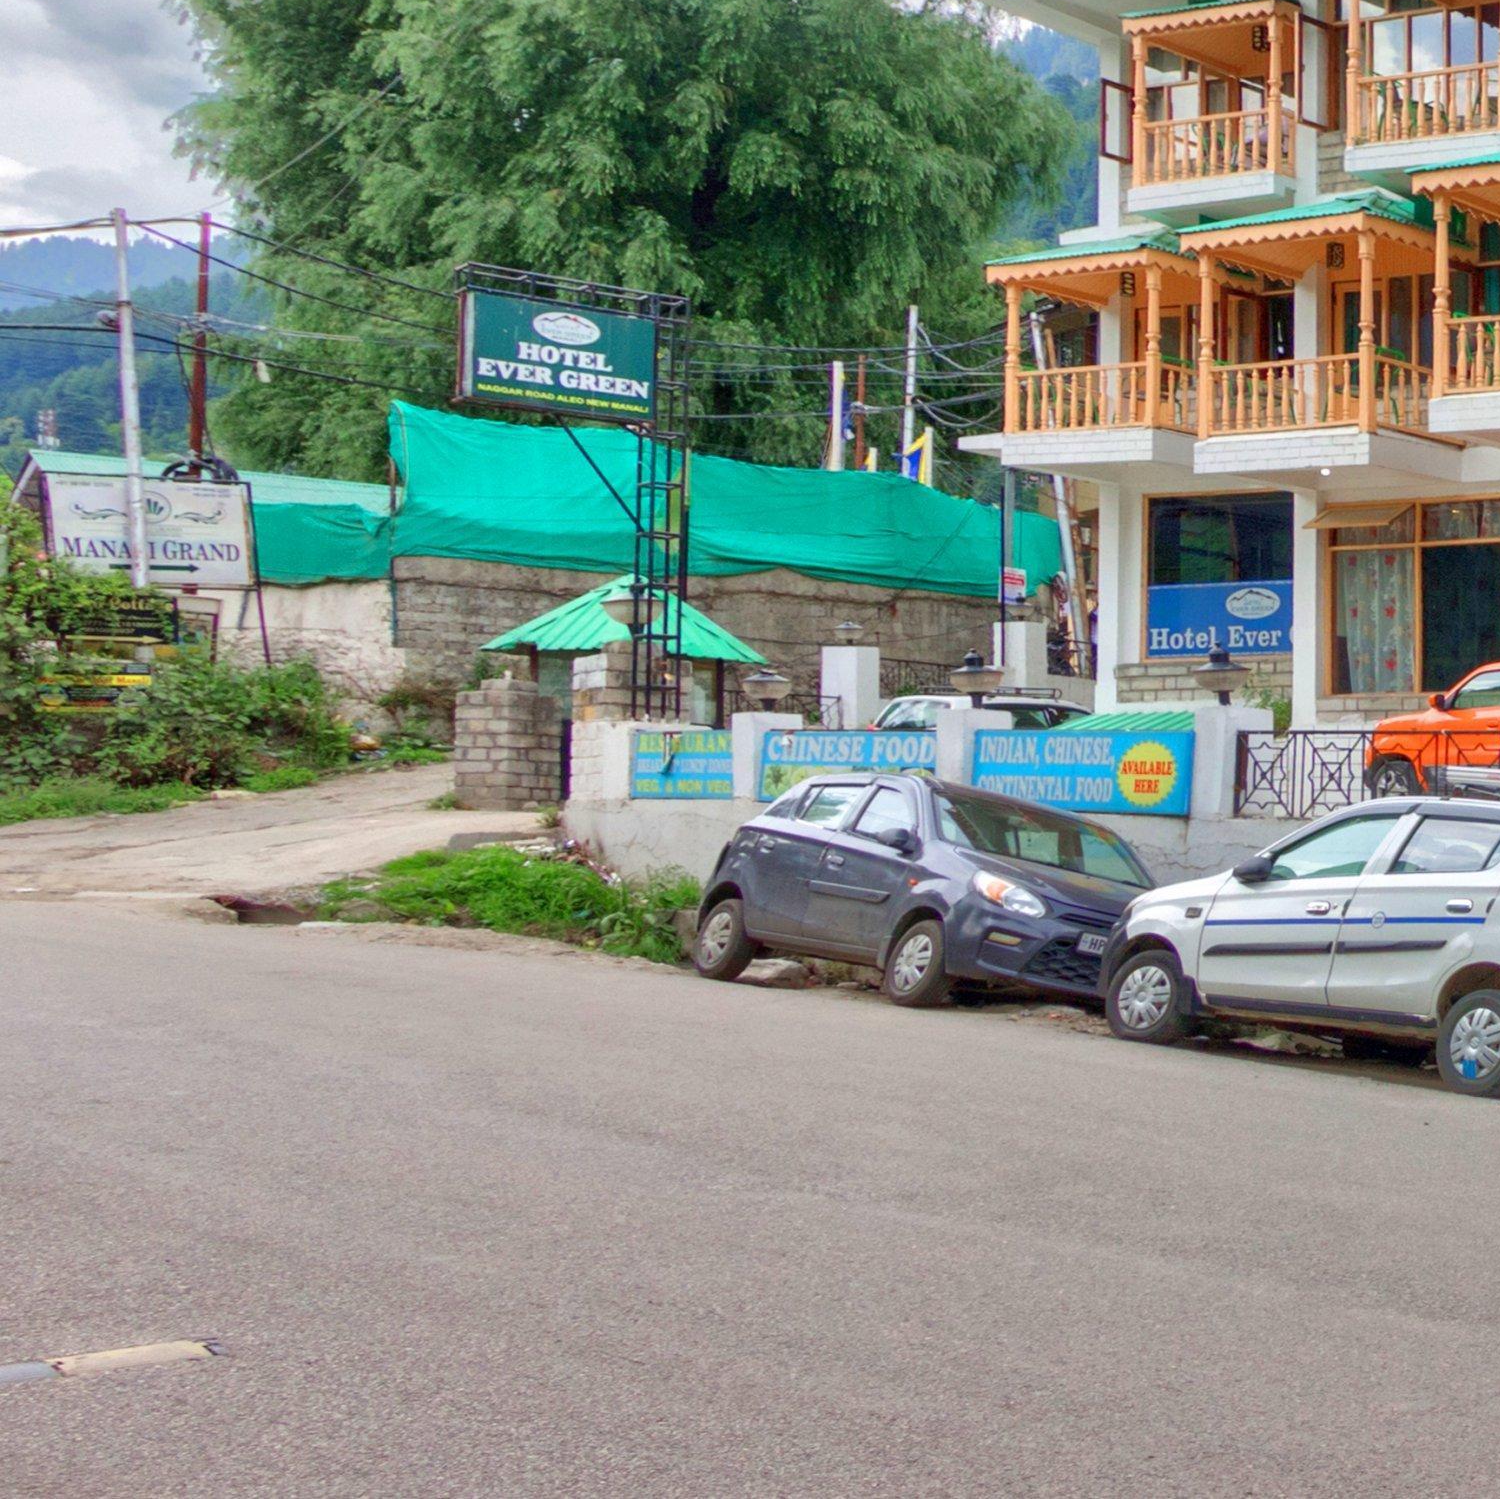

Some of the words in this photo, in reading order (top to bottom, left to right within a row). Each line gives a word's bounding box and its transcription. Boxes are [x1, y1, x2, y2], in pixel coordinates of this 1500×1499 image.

[518, 341, 613, 372] HOTEL
[477, 357, 554, 385] EVER
[559, 370, 650, 399] GREEN
[477, 383, 525, 397] NAGGAR
[525, 389, 556, 401] ROAD
[557, 394, 584, 405] ALEO
[586, 398, 611, 409] NEW
[611, 401, 649, 414] MANALI
[62, 536, 159, 560] MANAI
[163, 539, 240, 562] GRAND
[1150, 626, 1216, 650] Hotel
[1228, 625, 1282, 648] Ever
[768, 734, 865, 762] CHINESE
[871, 735, 936, 763] FOOD
[980, 736, 1040, 768] INDIAN,
[1044, 738, 1115, 771] CHINESE,
[1121, 760, 1173, 776] AVAILABLE
[1076, 776, 1112, 802] FOOD
[1133, 779, 1160, 794] HERE
